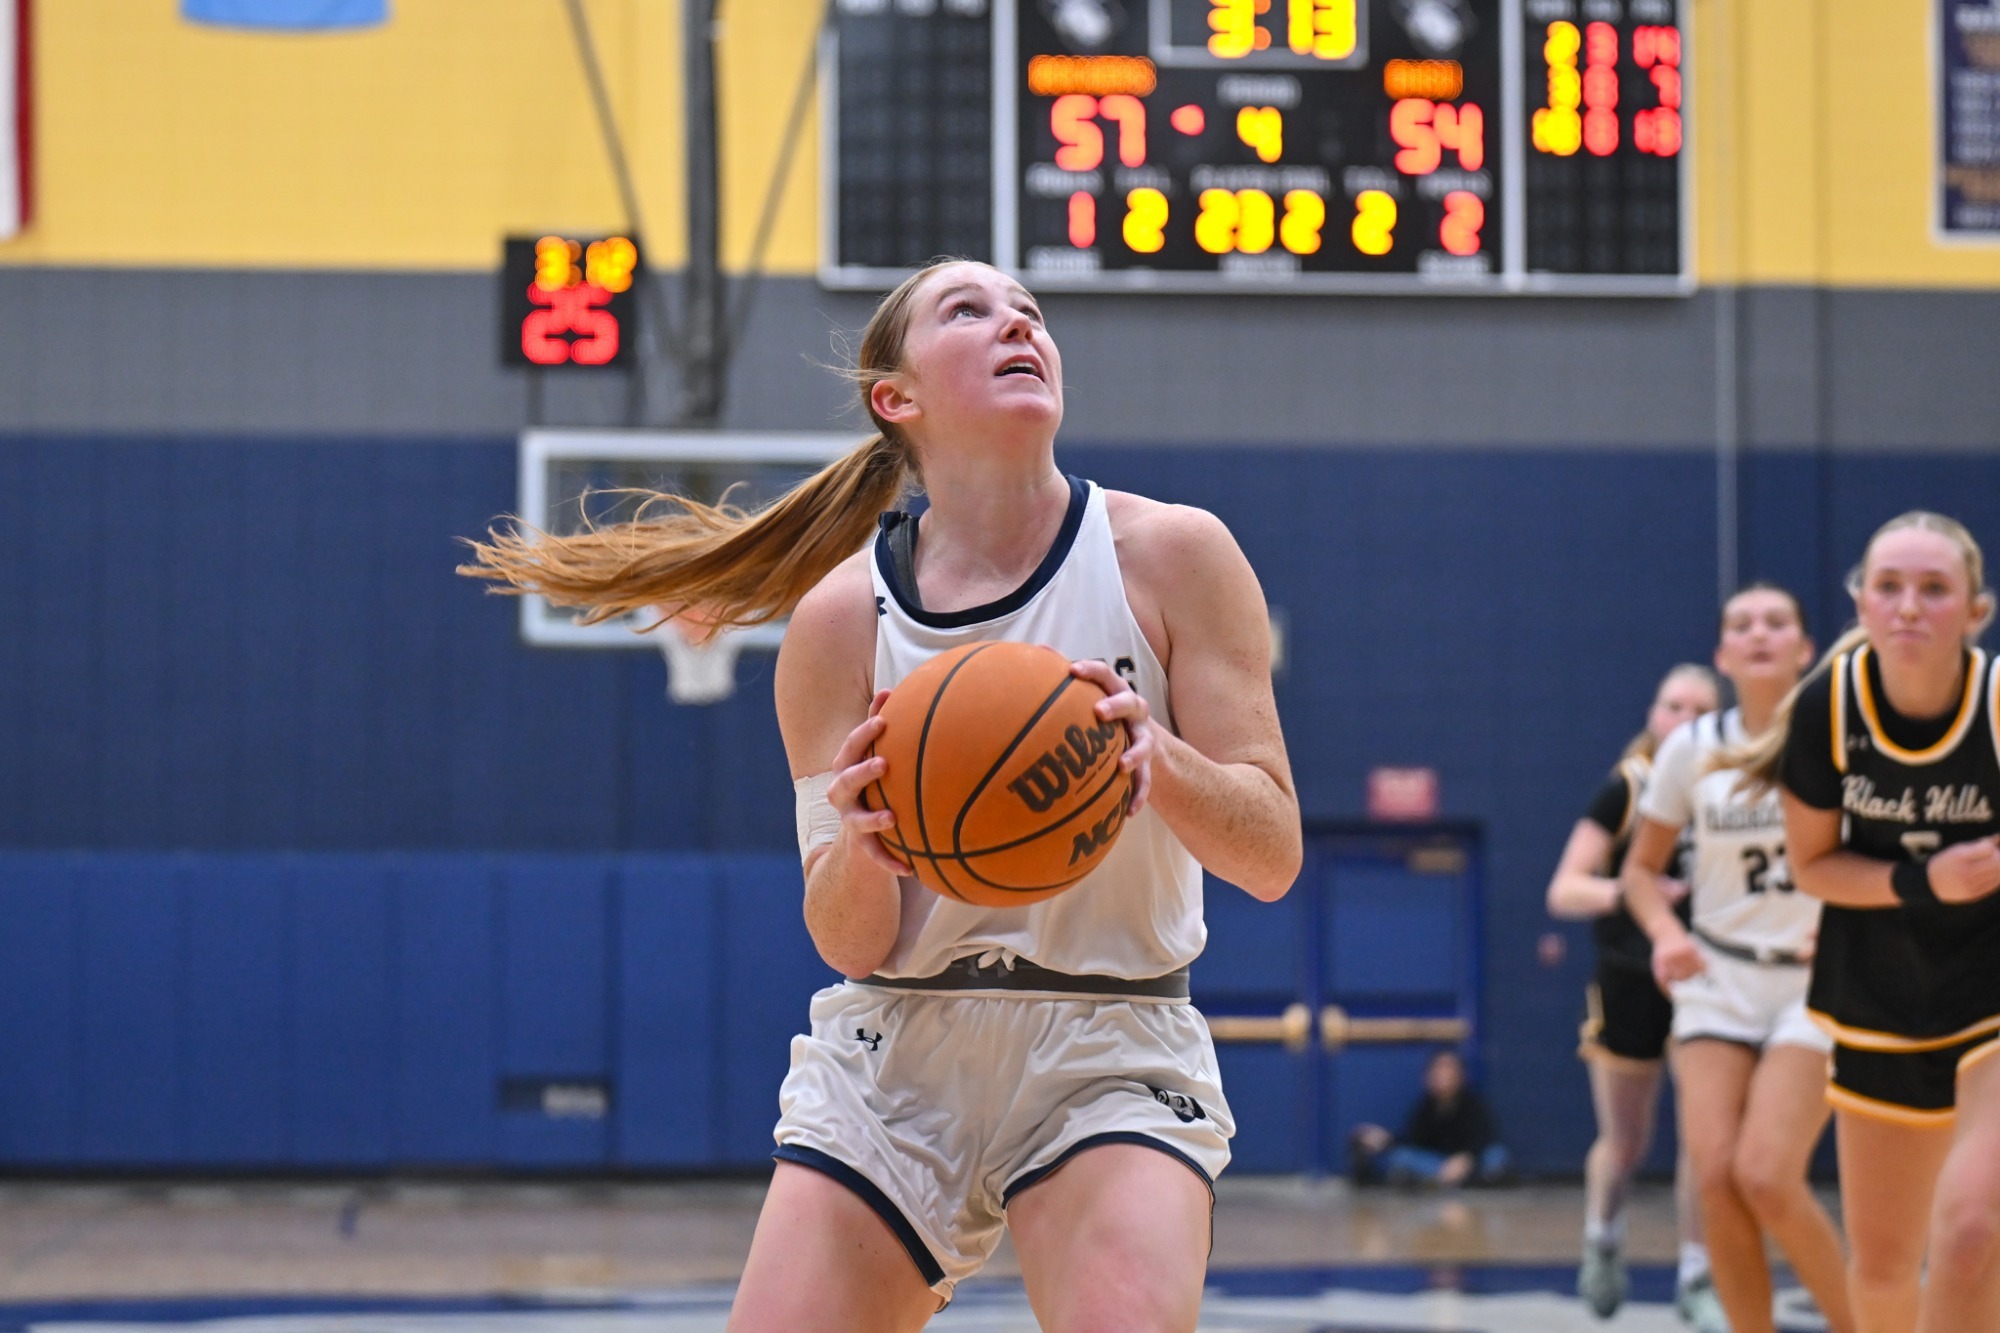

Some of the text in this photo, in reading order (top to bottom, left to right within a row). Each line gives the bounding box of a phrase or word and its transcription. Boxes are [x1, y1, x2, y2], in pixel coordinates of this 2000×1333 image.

[1207, 0, 1356, 60] 3:13
[1051, 94, 1146, 171] 57
[1236, 106, 1283, 162] 4
[1390, 98, 1484, 175] 54
[1068, 190, 1096, 248] 1
[1123, 187, 1169, 254] 2
[1352, 190, 1397, 256] 2
[1440, 191, 1484, 256] 2
[522, 280, 619, 365] 25
[1007, 720, 1121, 813] Wilso
[1842, 774, 1993, 824] Black Hills
